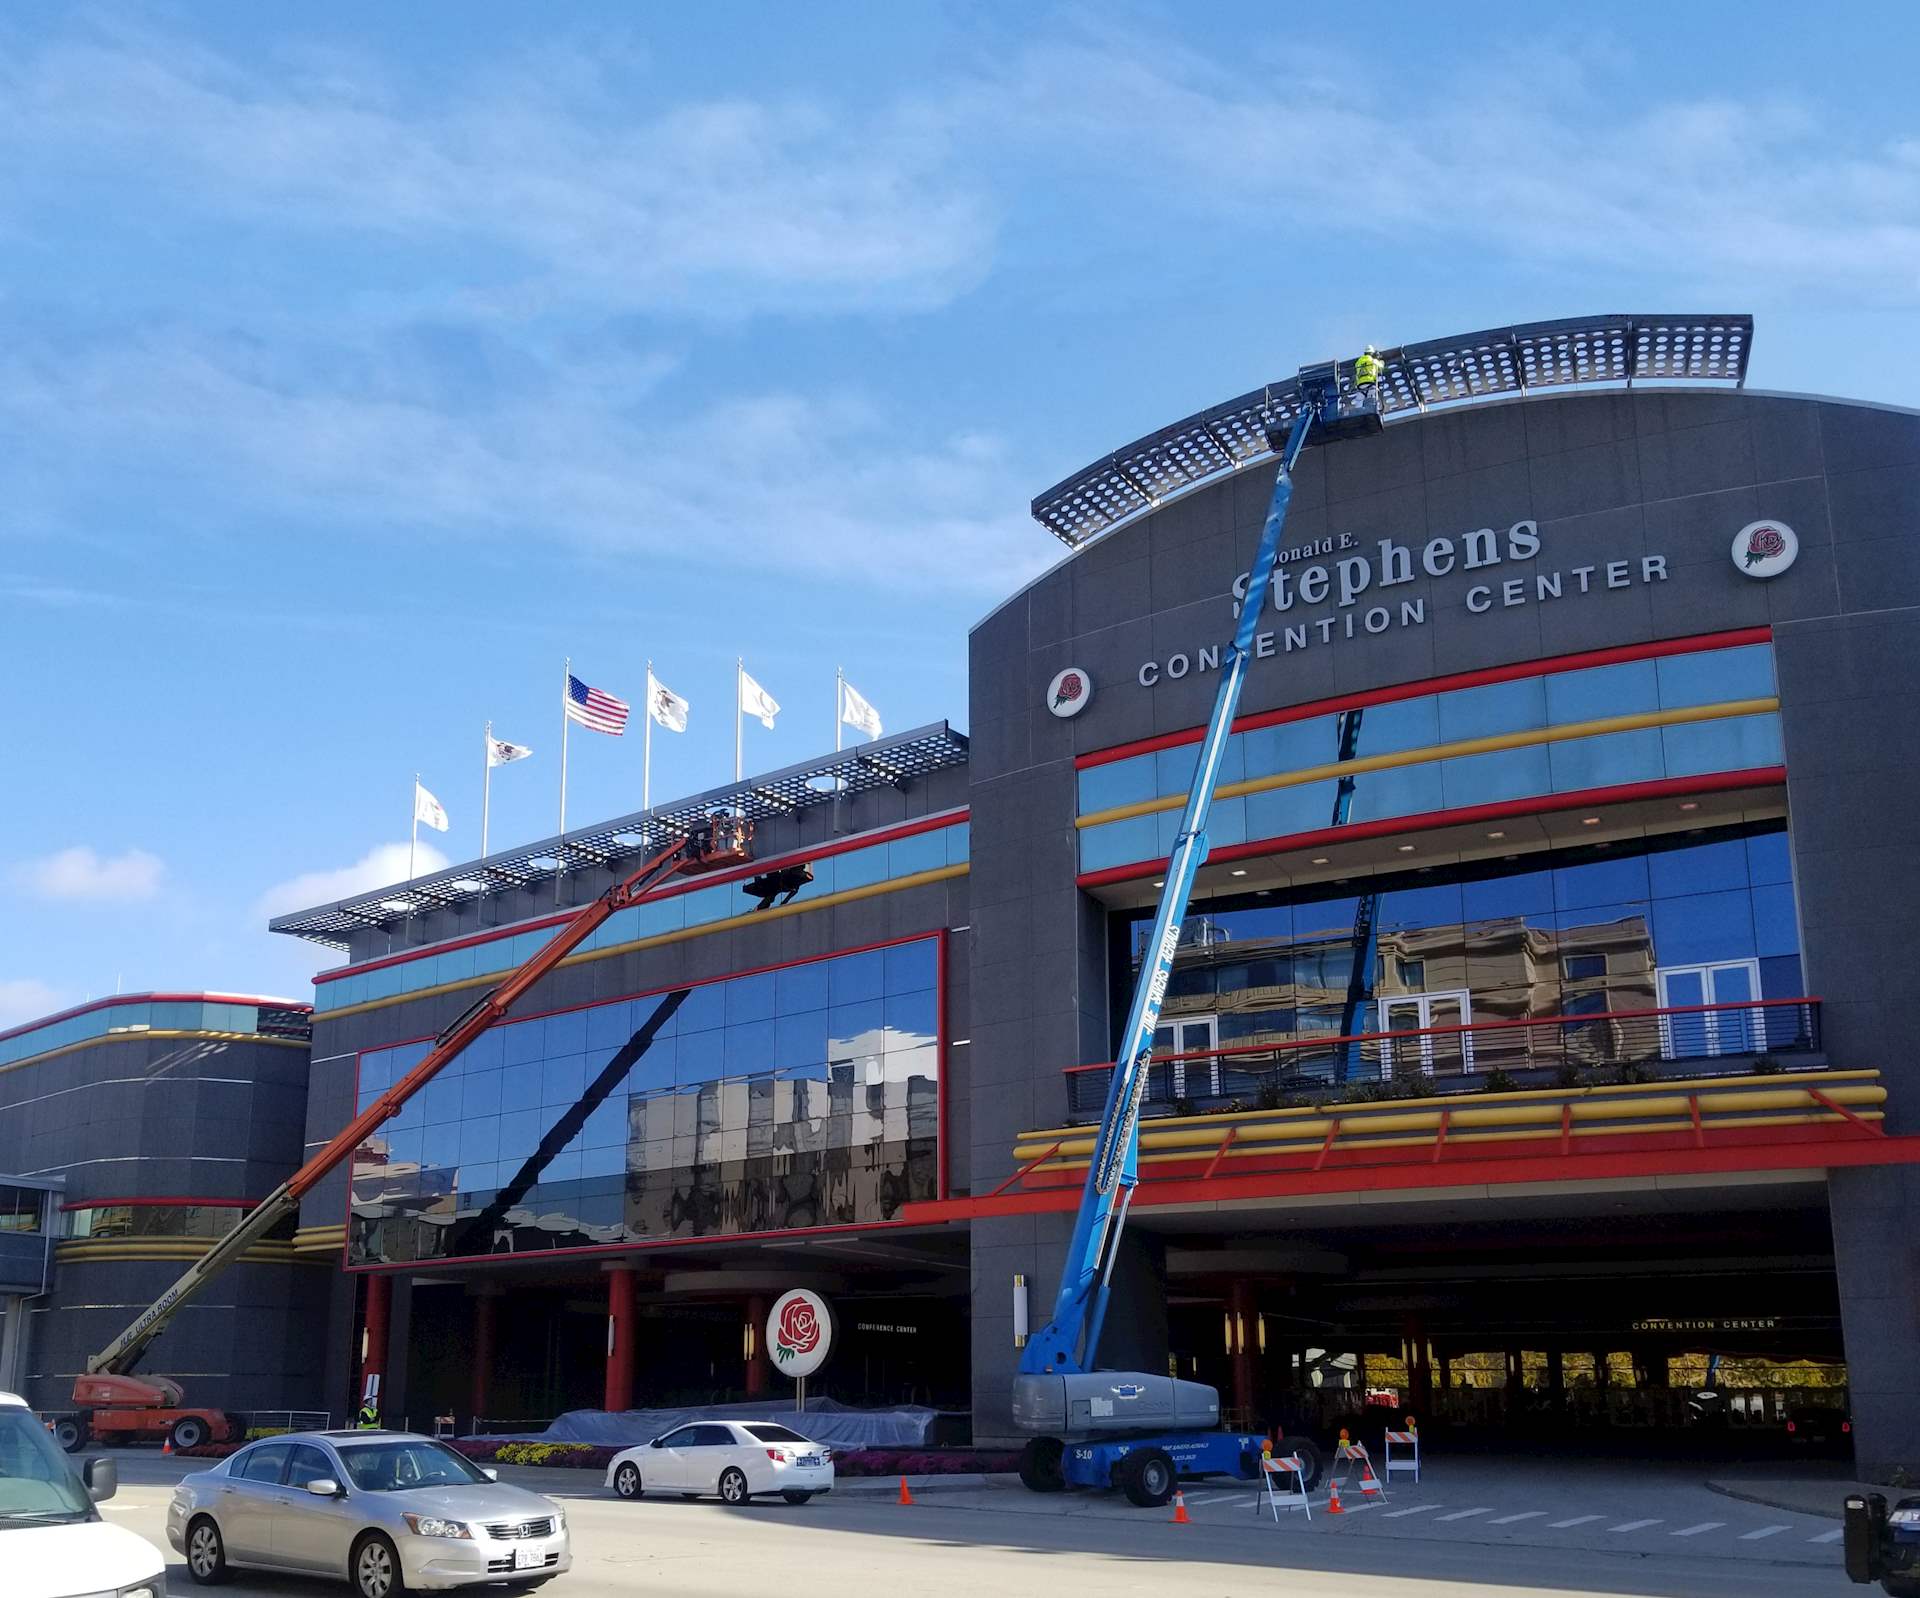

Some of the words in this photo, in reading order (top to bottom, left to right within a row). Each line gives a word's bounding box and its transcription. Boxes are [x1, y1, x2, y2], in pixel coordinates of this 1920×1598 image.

[1272, 536, 1333, 565] onald
[1339, 532, 1359, 548] E.
[1138, 598, 1425, 687] CONENTION
[1466, 555, 1667, 613] CENTER
[1632, 1321, 1715, 1330] CONVENTION
[1723, 1320, 1774, 1329] CENTER
[1076, 1449, 1093, 1460] S-10
